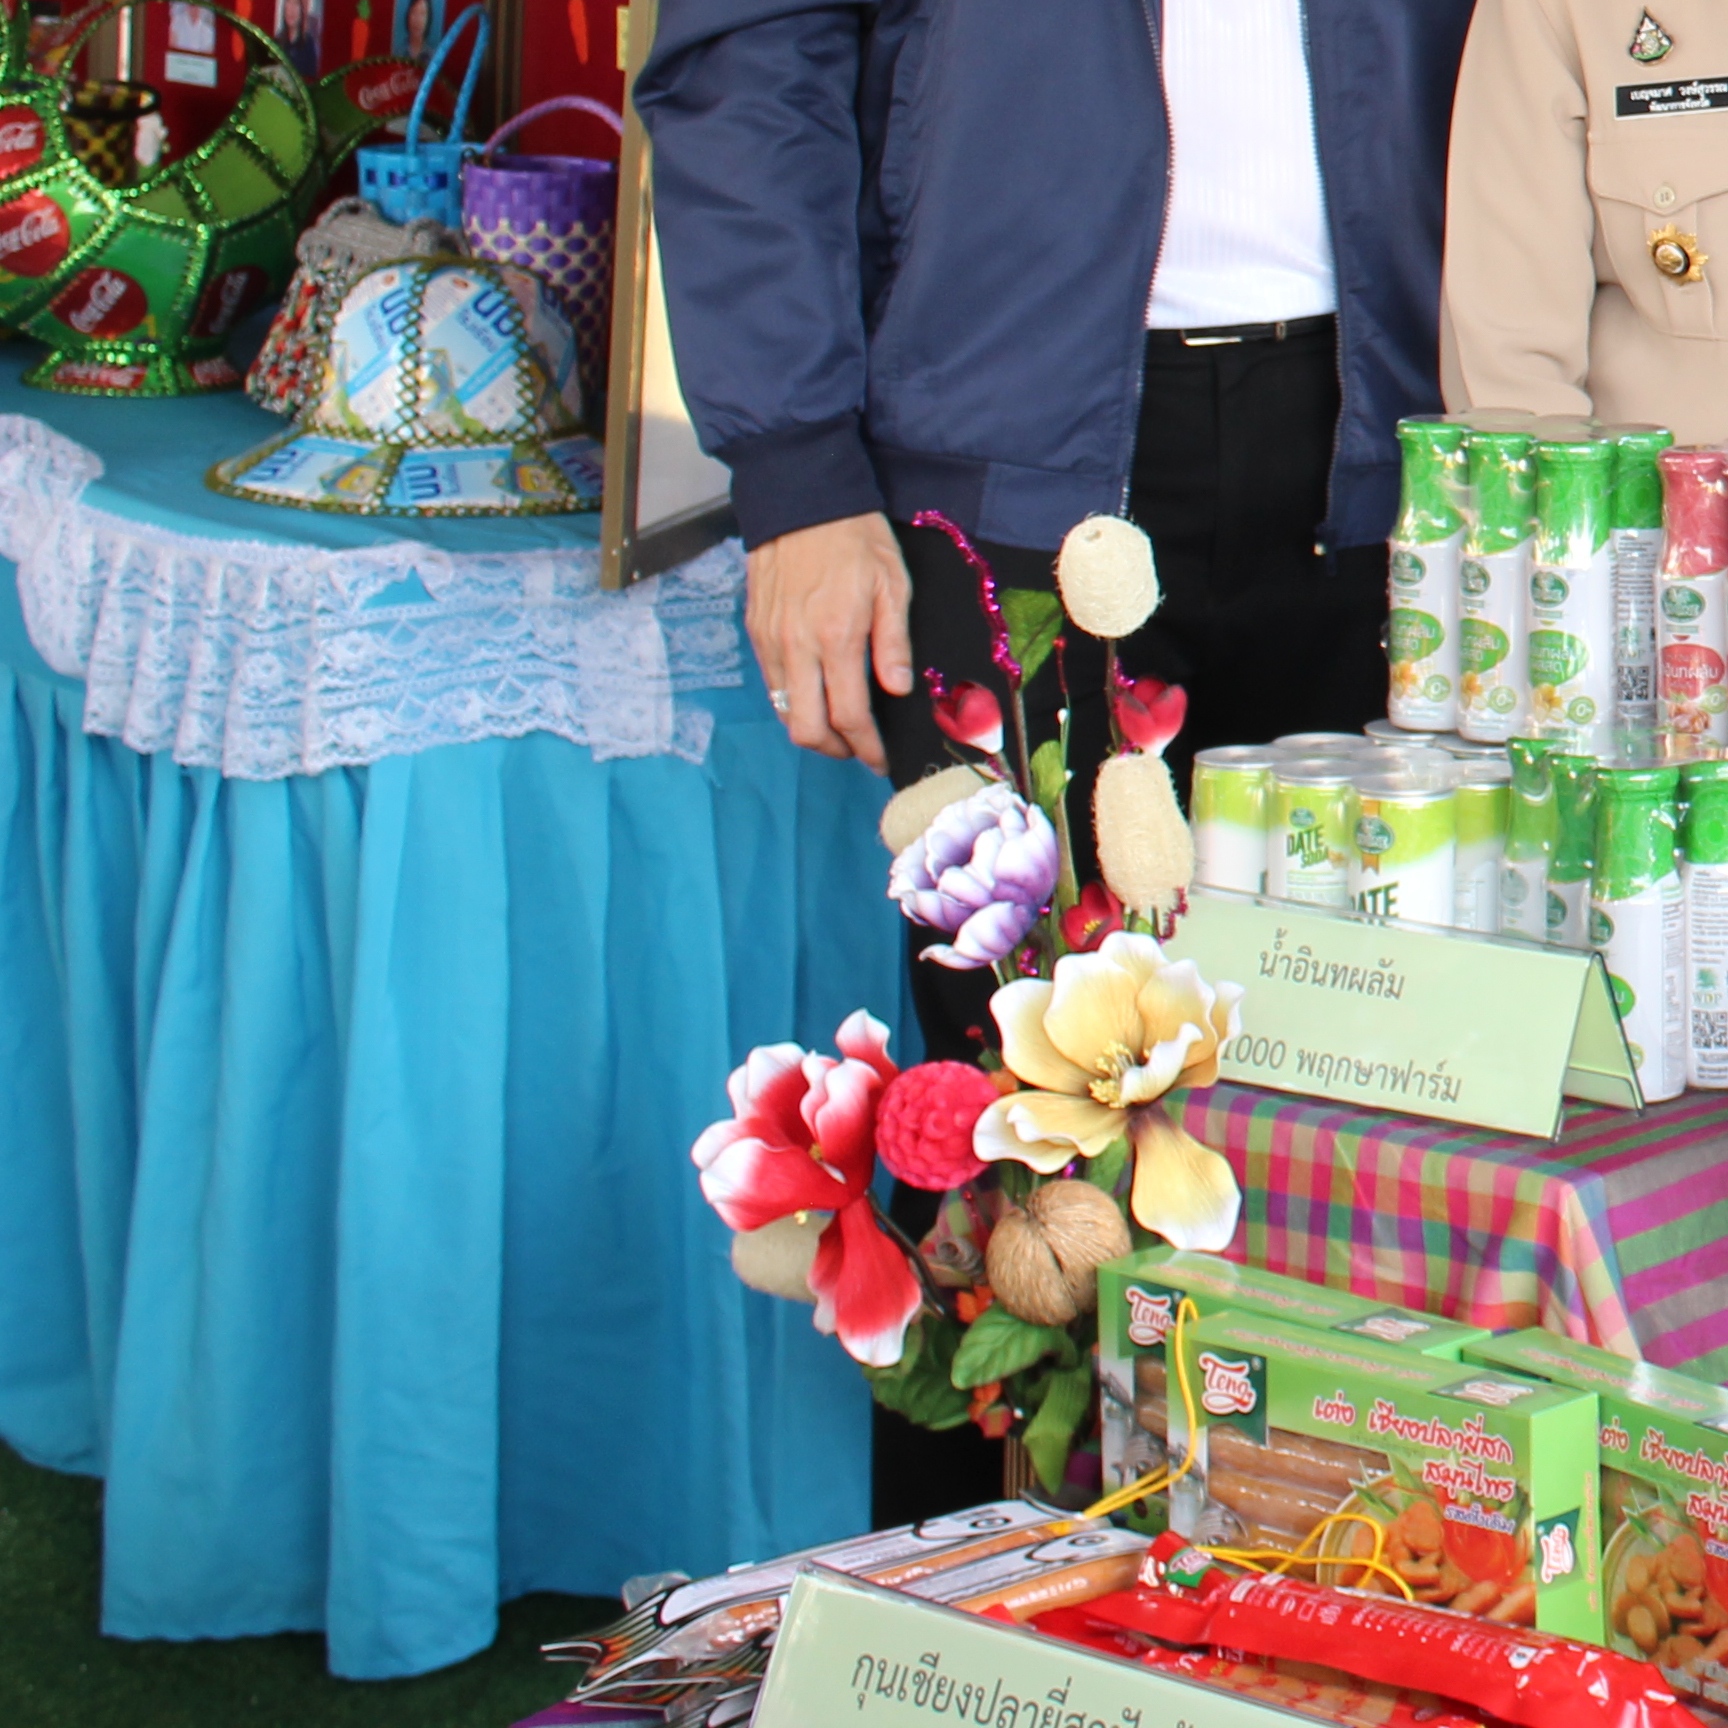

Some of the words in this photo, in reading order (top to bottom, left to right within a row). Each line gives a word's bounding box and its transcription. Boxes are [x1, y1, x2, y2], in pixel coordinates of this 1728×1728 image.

[1286, 825, 1325, 857] DATE
[1351, 881, 1400, 918] ATE
[1259, 927, 1405, 1001] น้ำอินทผลัม
[1221, 1033, 1288, 1070] 1000
[1296, 1048, 1463, 1104] พฤกษาฟาร์ม
[1600, 1415, 1630, 1452] ต่ง
[1423, 1458, 1516, 1502] สมุนไพร
